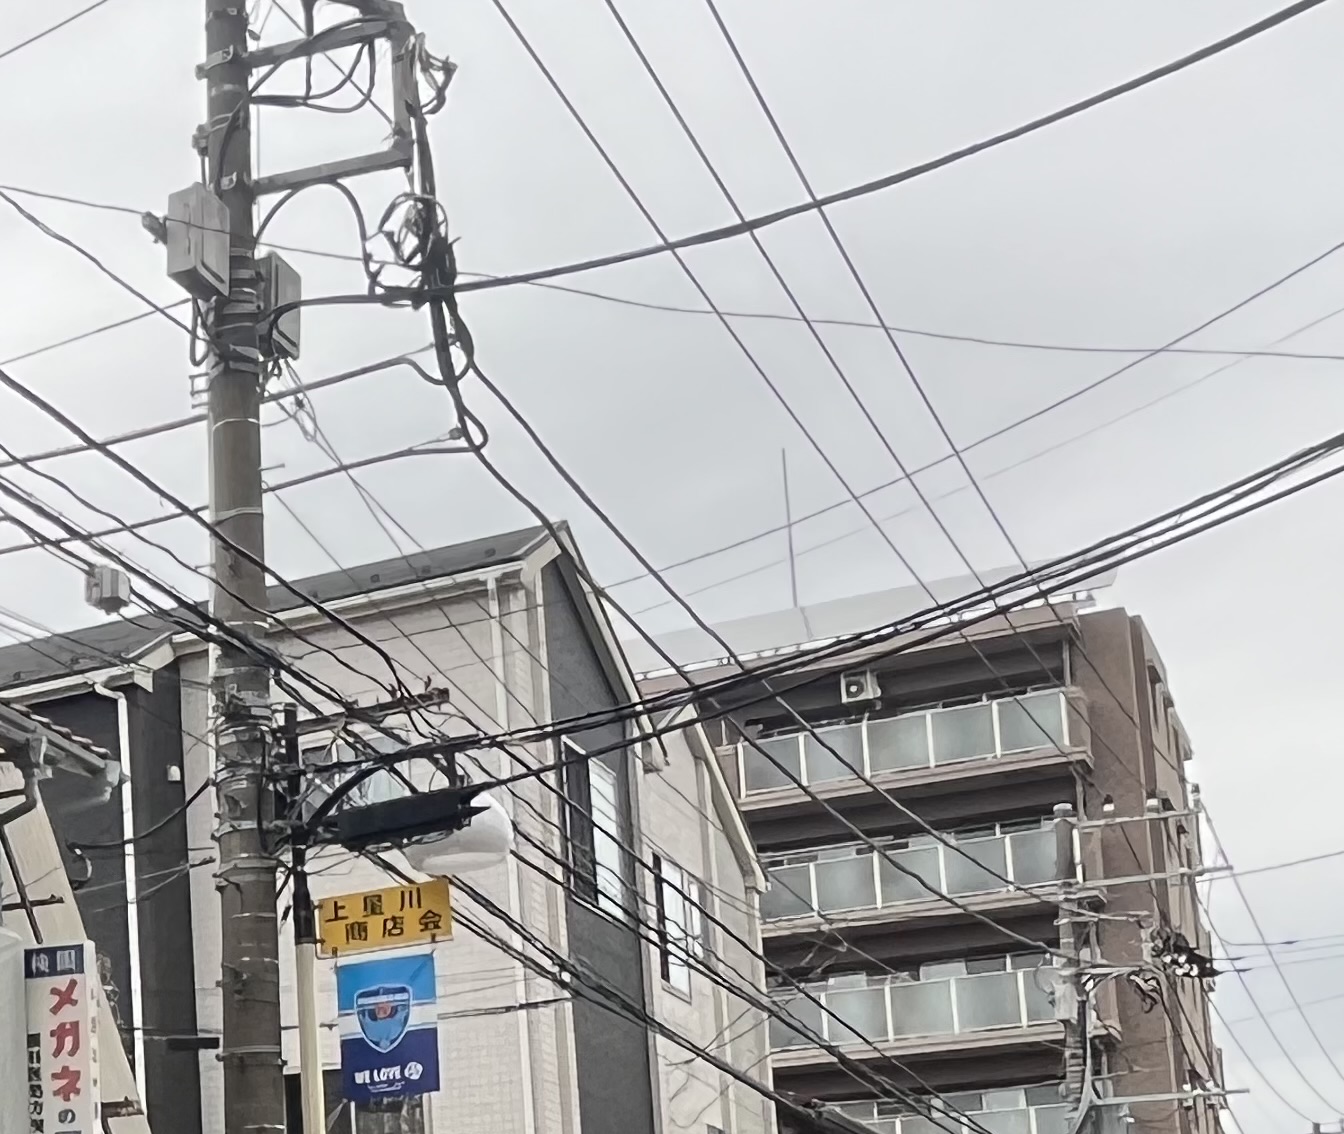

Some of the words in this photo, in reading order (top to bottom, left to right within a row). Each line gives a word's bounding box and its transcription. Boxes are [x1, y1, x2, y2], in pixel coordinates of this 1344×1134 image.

[325, 886, 423, 922] 上星川
[345, 909, 442, 944] 商店会
